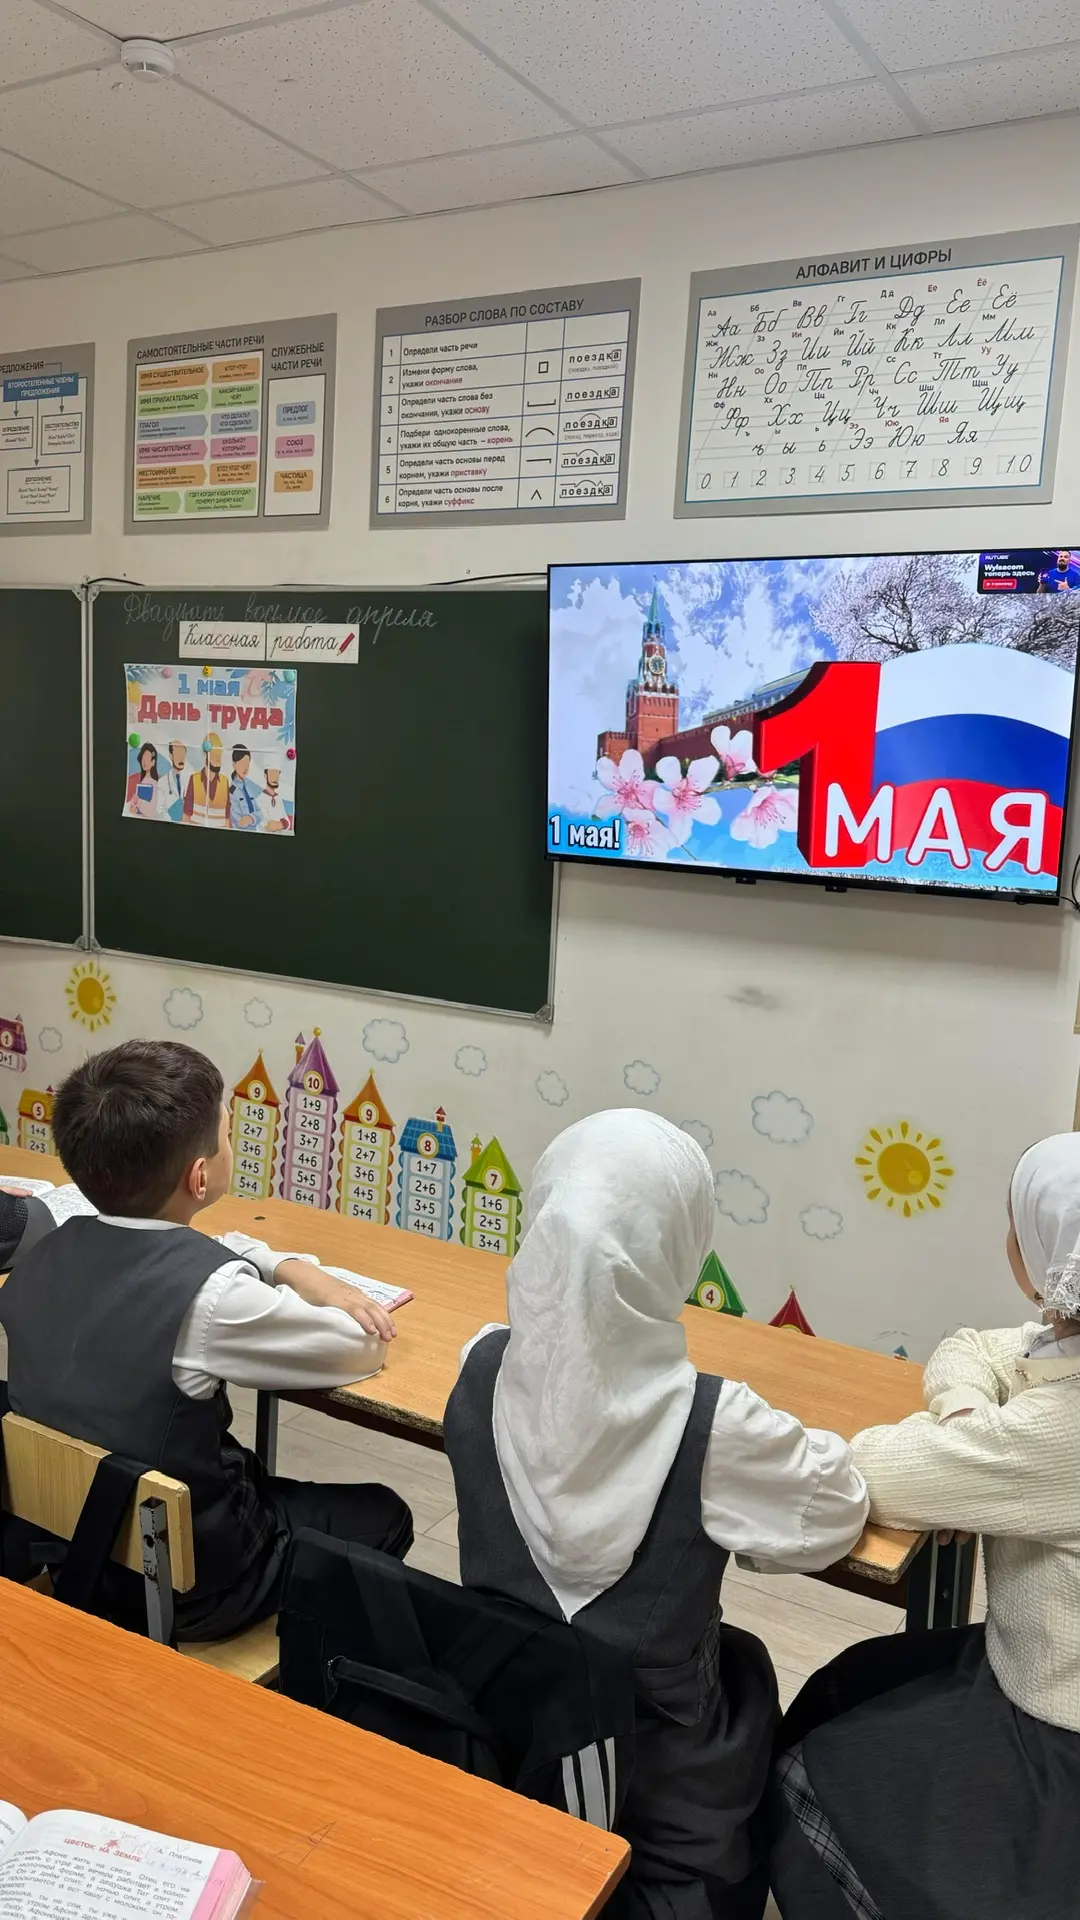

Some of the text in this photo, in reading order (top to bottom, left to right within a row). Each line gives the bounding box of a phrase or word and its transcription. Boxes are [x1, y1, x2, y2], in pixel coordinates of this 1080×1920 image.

[796, 248, 951, 279] АЛФАВИТ И ЦИФРЫ
[425, 299, 584, 326] РАЗБОР СЛОВА ПО СОСТАВУ
[137, 336, 264, 359] САМОСТОЯТЕЛЬНЫЕ ЧАСТИ РЕЧИ
[272, 342, 324, 357] СЛУЖЕБНЫЕ
[404, 346, 438, 357] Определи
[460, 342, 478, 352] речи
[569, 350, 620, 363] поездка
[153, 366, 204, 378] СУЩЕСТВИТЕЛЬНОЕ
[271, 358, 322, 371] ЧАСТИ РЕЧИ
[402, 368, 429, 376] Измени
[431, 366, 456, 376] форму
[456, 364, 478, 372] слова,
[56, 376, 74, 384] ЧЛЕНЫ
[402, 377, 462, 390] укажи окончание
[21, 386, 60, 397] ПРЕДЛОЖЕНИЯ
[153, 393, 198, 403] ПРИЛАГАТЕЛЬНОЕ
[567, 388, 617, 399] поездка
[283, 404, 308, 414] ПРЕДЛОГ
[388, 406, 393, 414] 3
[402, 397, 436, 407] Определи
[437, 395, 456, 403] часть
[480, 392, 493, 400] без
[401, 405, 490, 419] окончания, укажи основу
[565, 418, 615, 429] поездка
[400, 430, 430, 439] Подбери
[434, 426, 486, 436] однокоренные
[487, 424, 510, 432] слова,
[400, 442, 421, 450] укажи
[433, 440, 456, 449] общую
[487, 436, 513, 445] корень
[386, 466, 391, 474] 5
[400, 459, 434, 468] Определи
[483, 455, 505, 464] перед
[563, 454, 612, 466] поездка
[399, 468, 488, 480] корнем, укажи приставку
[701, 473, 711, 488] 0
[731, 472, 738, 487] 1
[756, 470, 766, 485] 2
[785, 468, 796, 484] 3
[814, 466, 825, 482] 4
[842, 464, 855, 481] 5
[875, 462, 886, 479] 6
[906, 460, 917, 476] 7
[938, 459, 949, 476] 8
[970, 457, 982, 474] 9
[398, 489, 432, 497] Определи
[454, 486, 480, 494] основы
[562, 486, 610, 496] поездка
[421, 499, 442, 507] укажи
[444, 497, 474, 506] суффикс
[984, 564, 1024, 572] Wylsacom
[245, 592, 327, 623] восьмое
[346, 606, 439, 644] апреля
[184, 624, 339, 658] Классная работа
[178, 674, 240, 697] 1 мая
[138, 695, 284, 730] День труда
[752, 661, 881, 868] 1
[549, 814, 621, 850] 1 мая!
[824, 782, 1050, 876] МАЯ
[4, 1034, 9, 1044] 1
[308, 1077, 320, 1090] 10
[254, 1088, 261, 1098] 9
[36, 1106, 41, 1116] 5
[303, 1097, 321, 1111] 1+9
[246, 1105, 264, 1120] 1+8
[366, 1109, 372, 1121] 9
[301, 1115, 320, 1130] 2+8
[31, 1125, 46, 1137] 1+4
[244, 1123, 262, 1138] 2+7
[358, 1129, 377, 1144] 1+8
[30, 1140, 46, 1154] 2+3
[242, 1141, 261, 1156] 3+6
[300, 1134, 318, 1149] 3+7
[424, 1140, 431, 1151] 8
[298, 1153, 317, 1168] 4+6
[356, 1148, 375, 1162] 2+7
[241, 1159, 260, 1174] 4+5
[354, 1166, 374, 1182] 3+6
[416, 1160, 437, 1175] 1+7
[239, 1176, 257, 1192] 5+4
[297, 1171, 316, 1186] 5+5
[490, 1174, 498, 1187] 7
[353, 1186, 373, 1200] 4+5
[415, 1180, 436, 1194] 2+6
[295, 1190, 314, 1204] 6+4
[481, 1196, 502, 1211] 1+6
[352, 1204, 372, 1220] 5+4
[414, 1199, 435, 1215] 3+5
[413, 1219, 434, 1234] 4+4
[480, 1215, 501, 1231] 2+5
[479, 1235, 500, 1251] 3+4
[706, 1289, 714, 1304] 4
[64, 1838, 142, 1863] ЦВЕТОК НА ЗЕМЛЕ
[169, 1851, 202, 1864] Платонов
